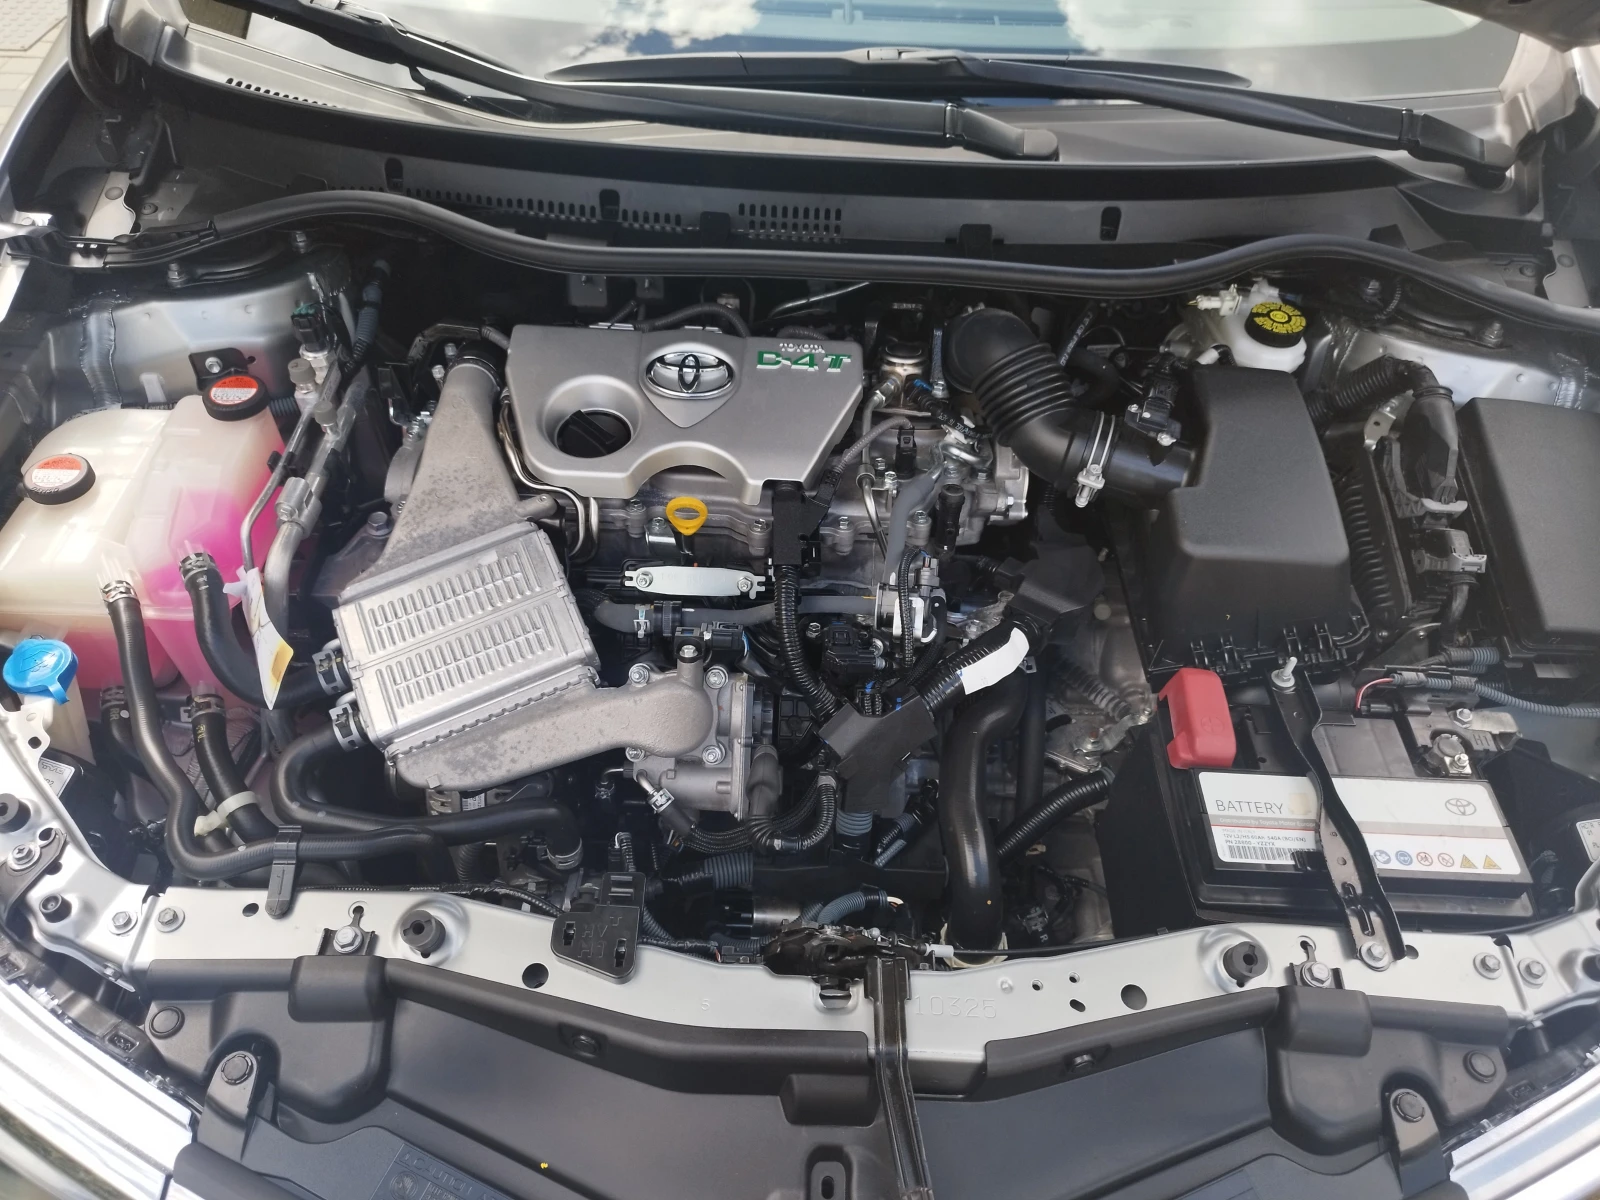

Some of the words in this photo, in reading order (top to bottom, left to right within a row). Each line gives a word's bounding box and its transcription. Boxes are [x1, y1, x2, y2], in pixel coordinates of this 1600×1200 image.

[779, 342, 825, 353] TOYOTA
[1215, 799, 1284, 815] BATTERY
[915, 994, 998, 1019] 10325
[412, 1157, 474, 1196] CAUTION
